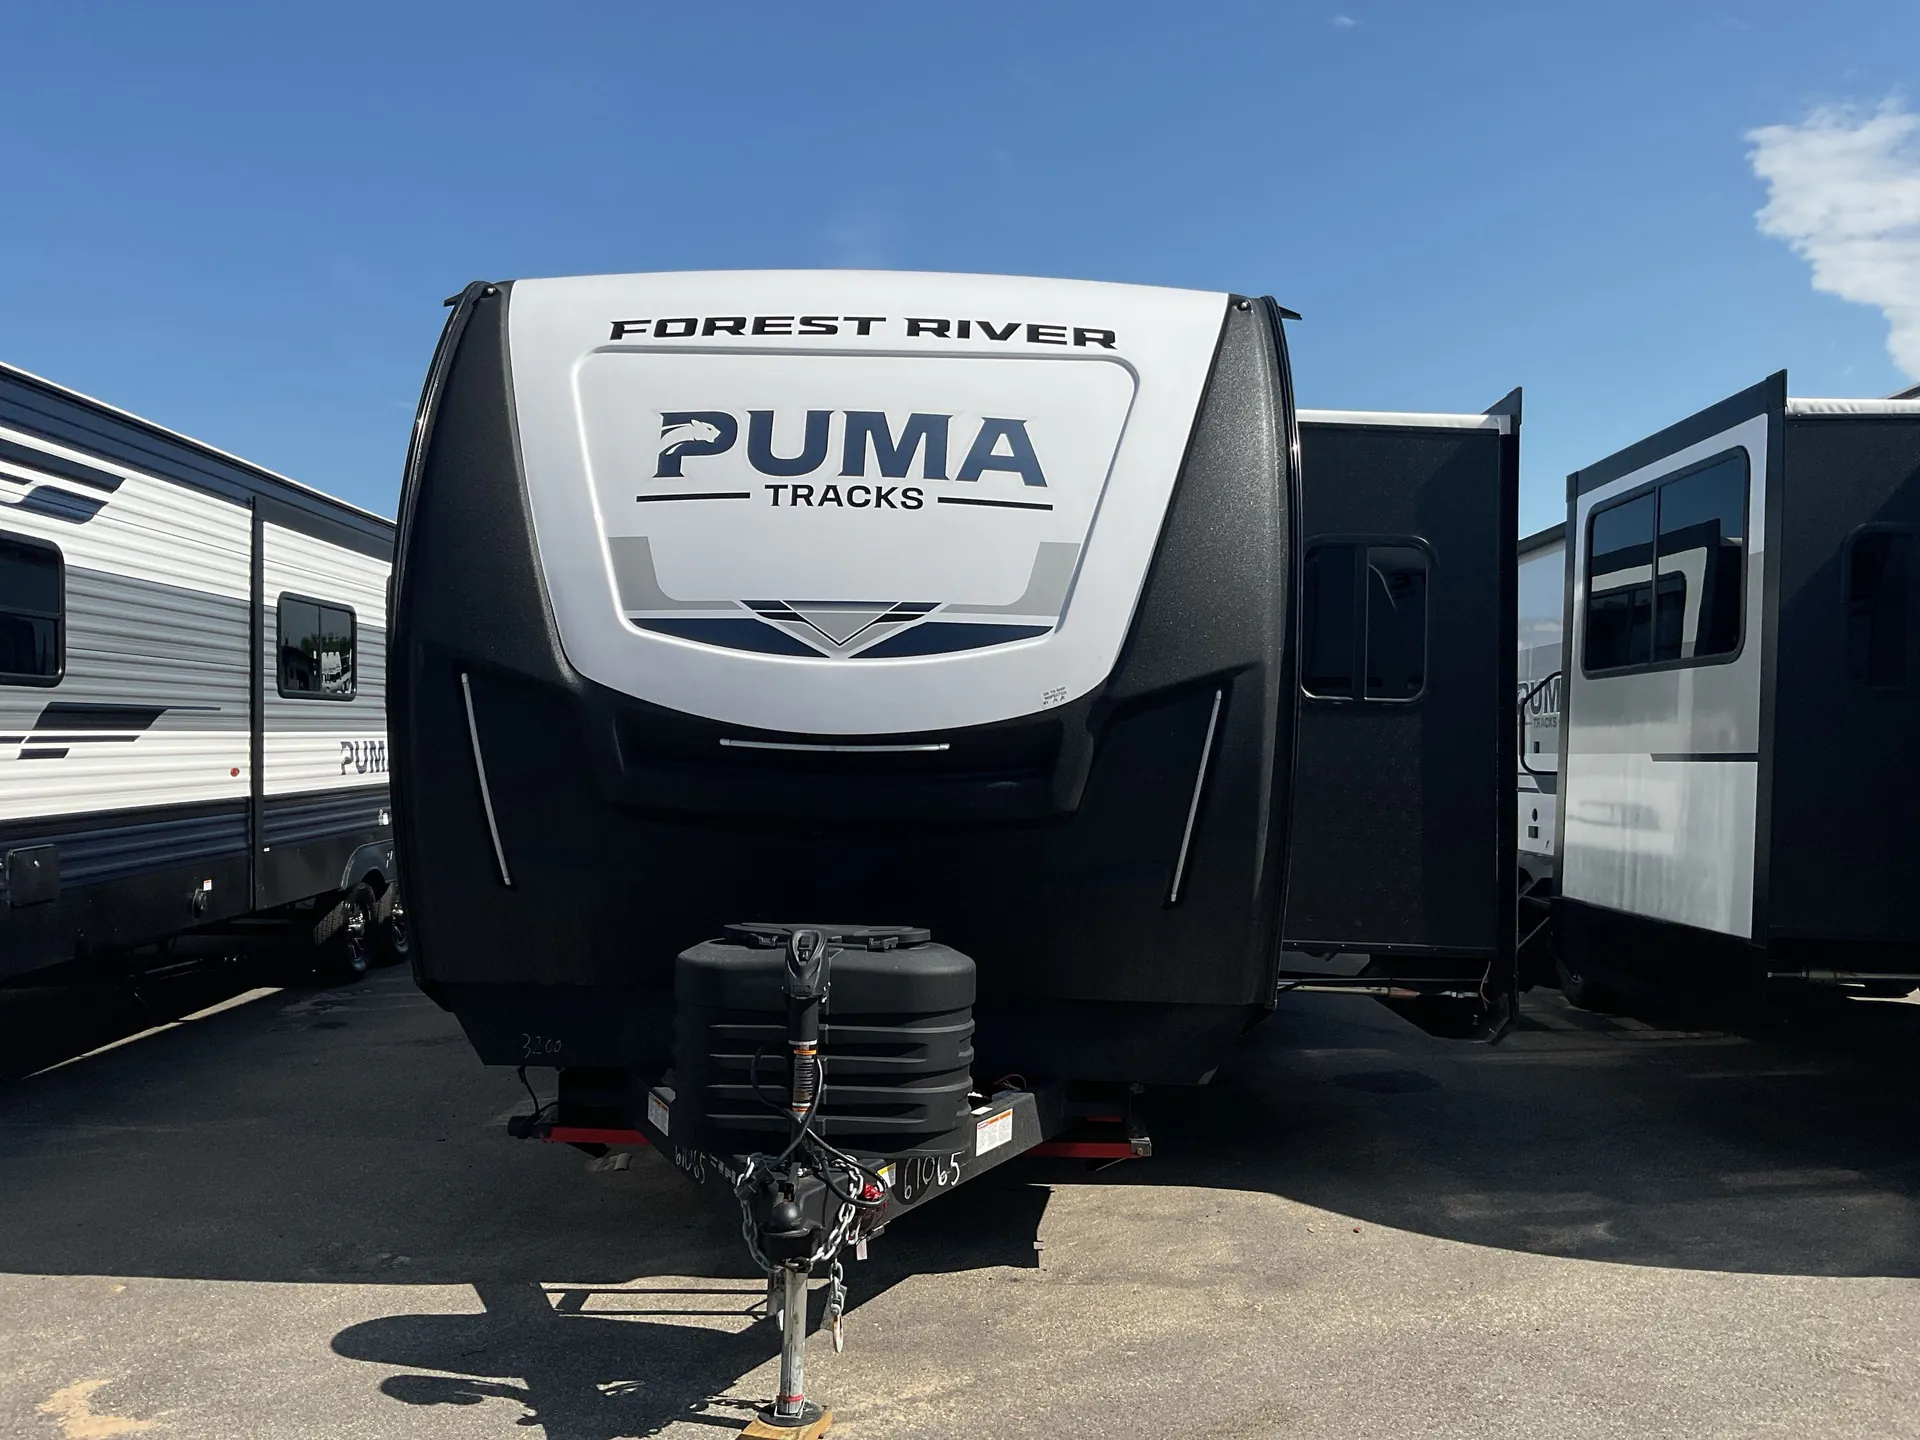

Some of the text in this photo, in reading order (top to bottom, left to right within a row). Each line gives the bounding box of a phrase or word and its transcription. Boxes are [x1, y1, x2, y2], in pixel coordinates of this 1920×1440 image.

[609, 316, 1117, 350] FOREST RIVER
[652, 409, 1048, 489] PUMA
[764, 483, 924, 510] TRACKS
[340, 740, 389, 776] PUM
[522, 1033, 562, 1060] 3200
[904, 1150, 965, 1200] 61065
